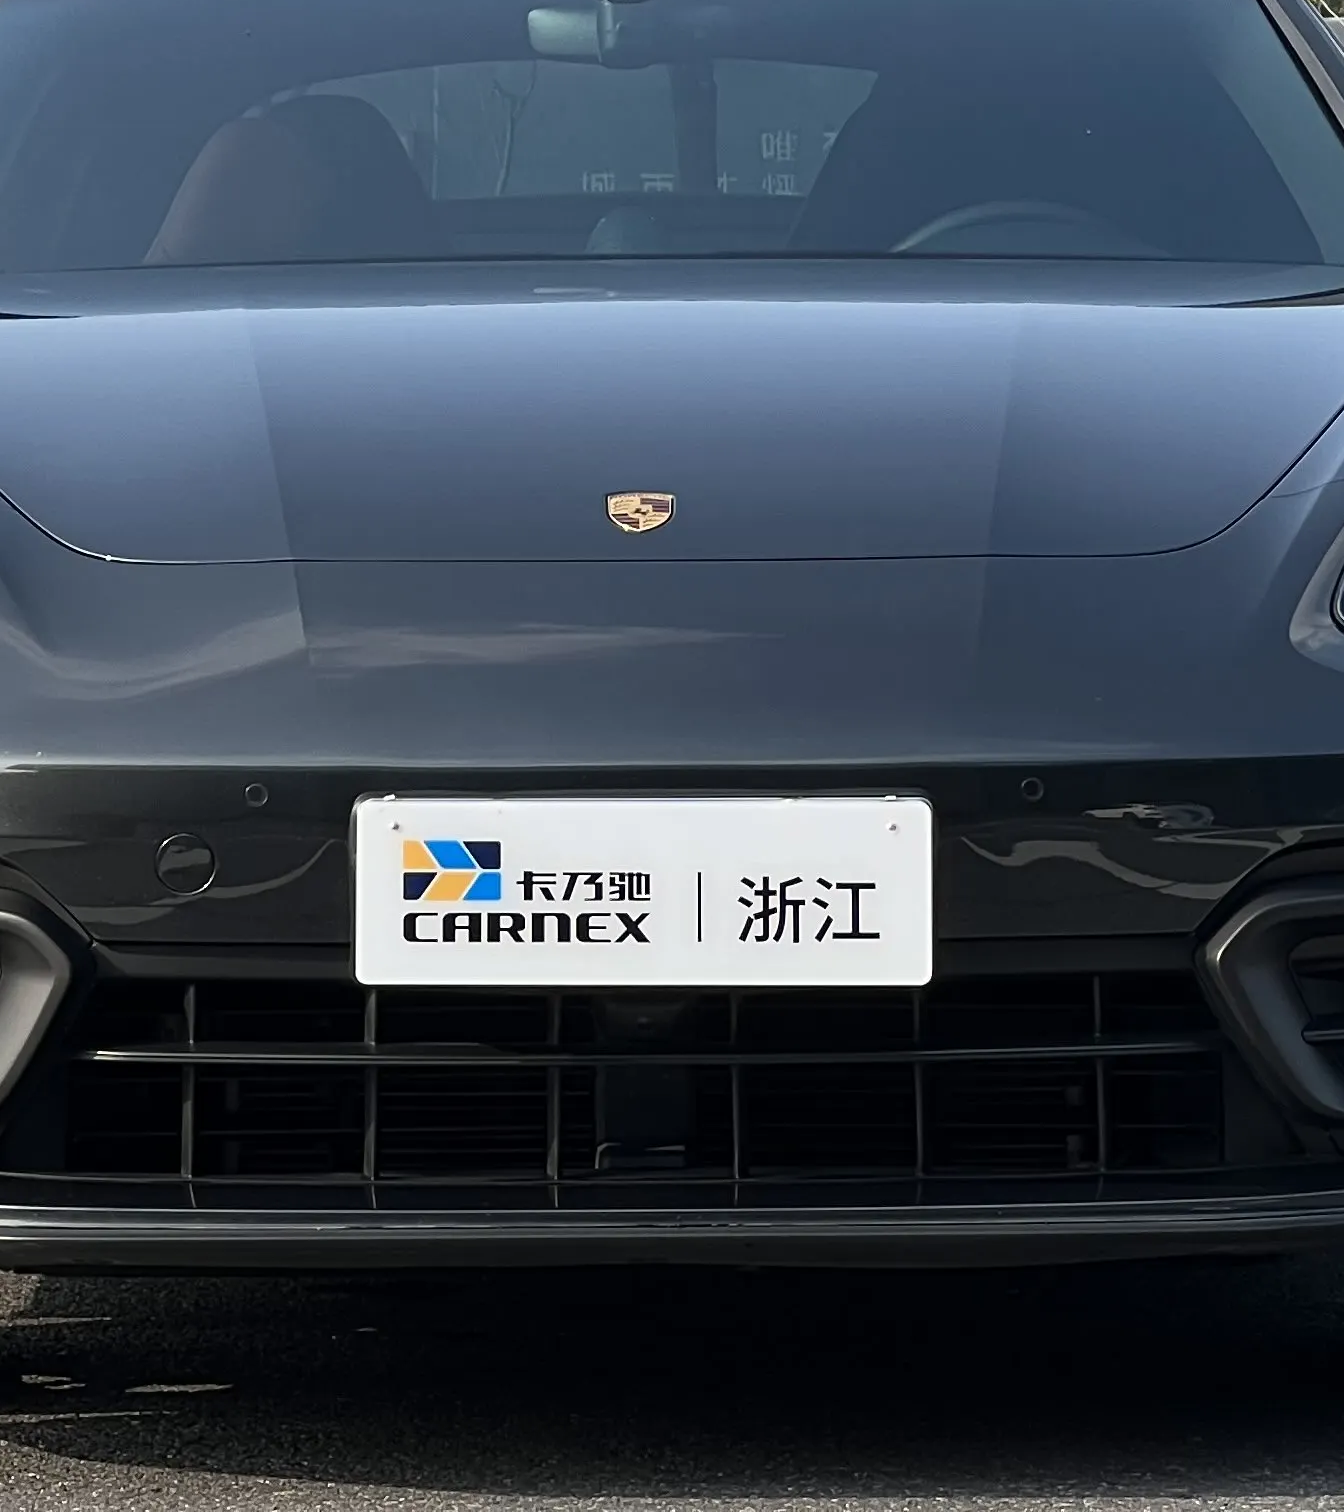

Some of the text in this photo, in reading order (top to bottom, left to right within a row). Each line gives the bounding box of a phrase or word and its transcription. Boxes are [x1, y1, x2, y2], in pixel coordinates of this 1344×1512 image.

[515, 870, 652, 903] 卡乃驰
[737, 875, 882, 945] 浙江
[403, 912, 652, 944] CARNEX
